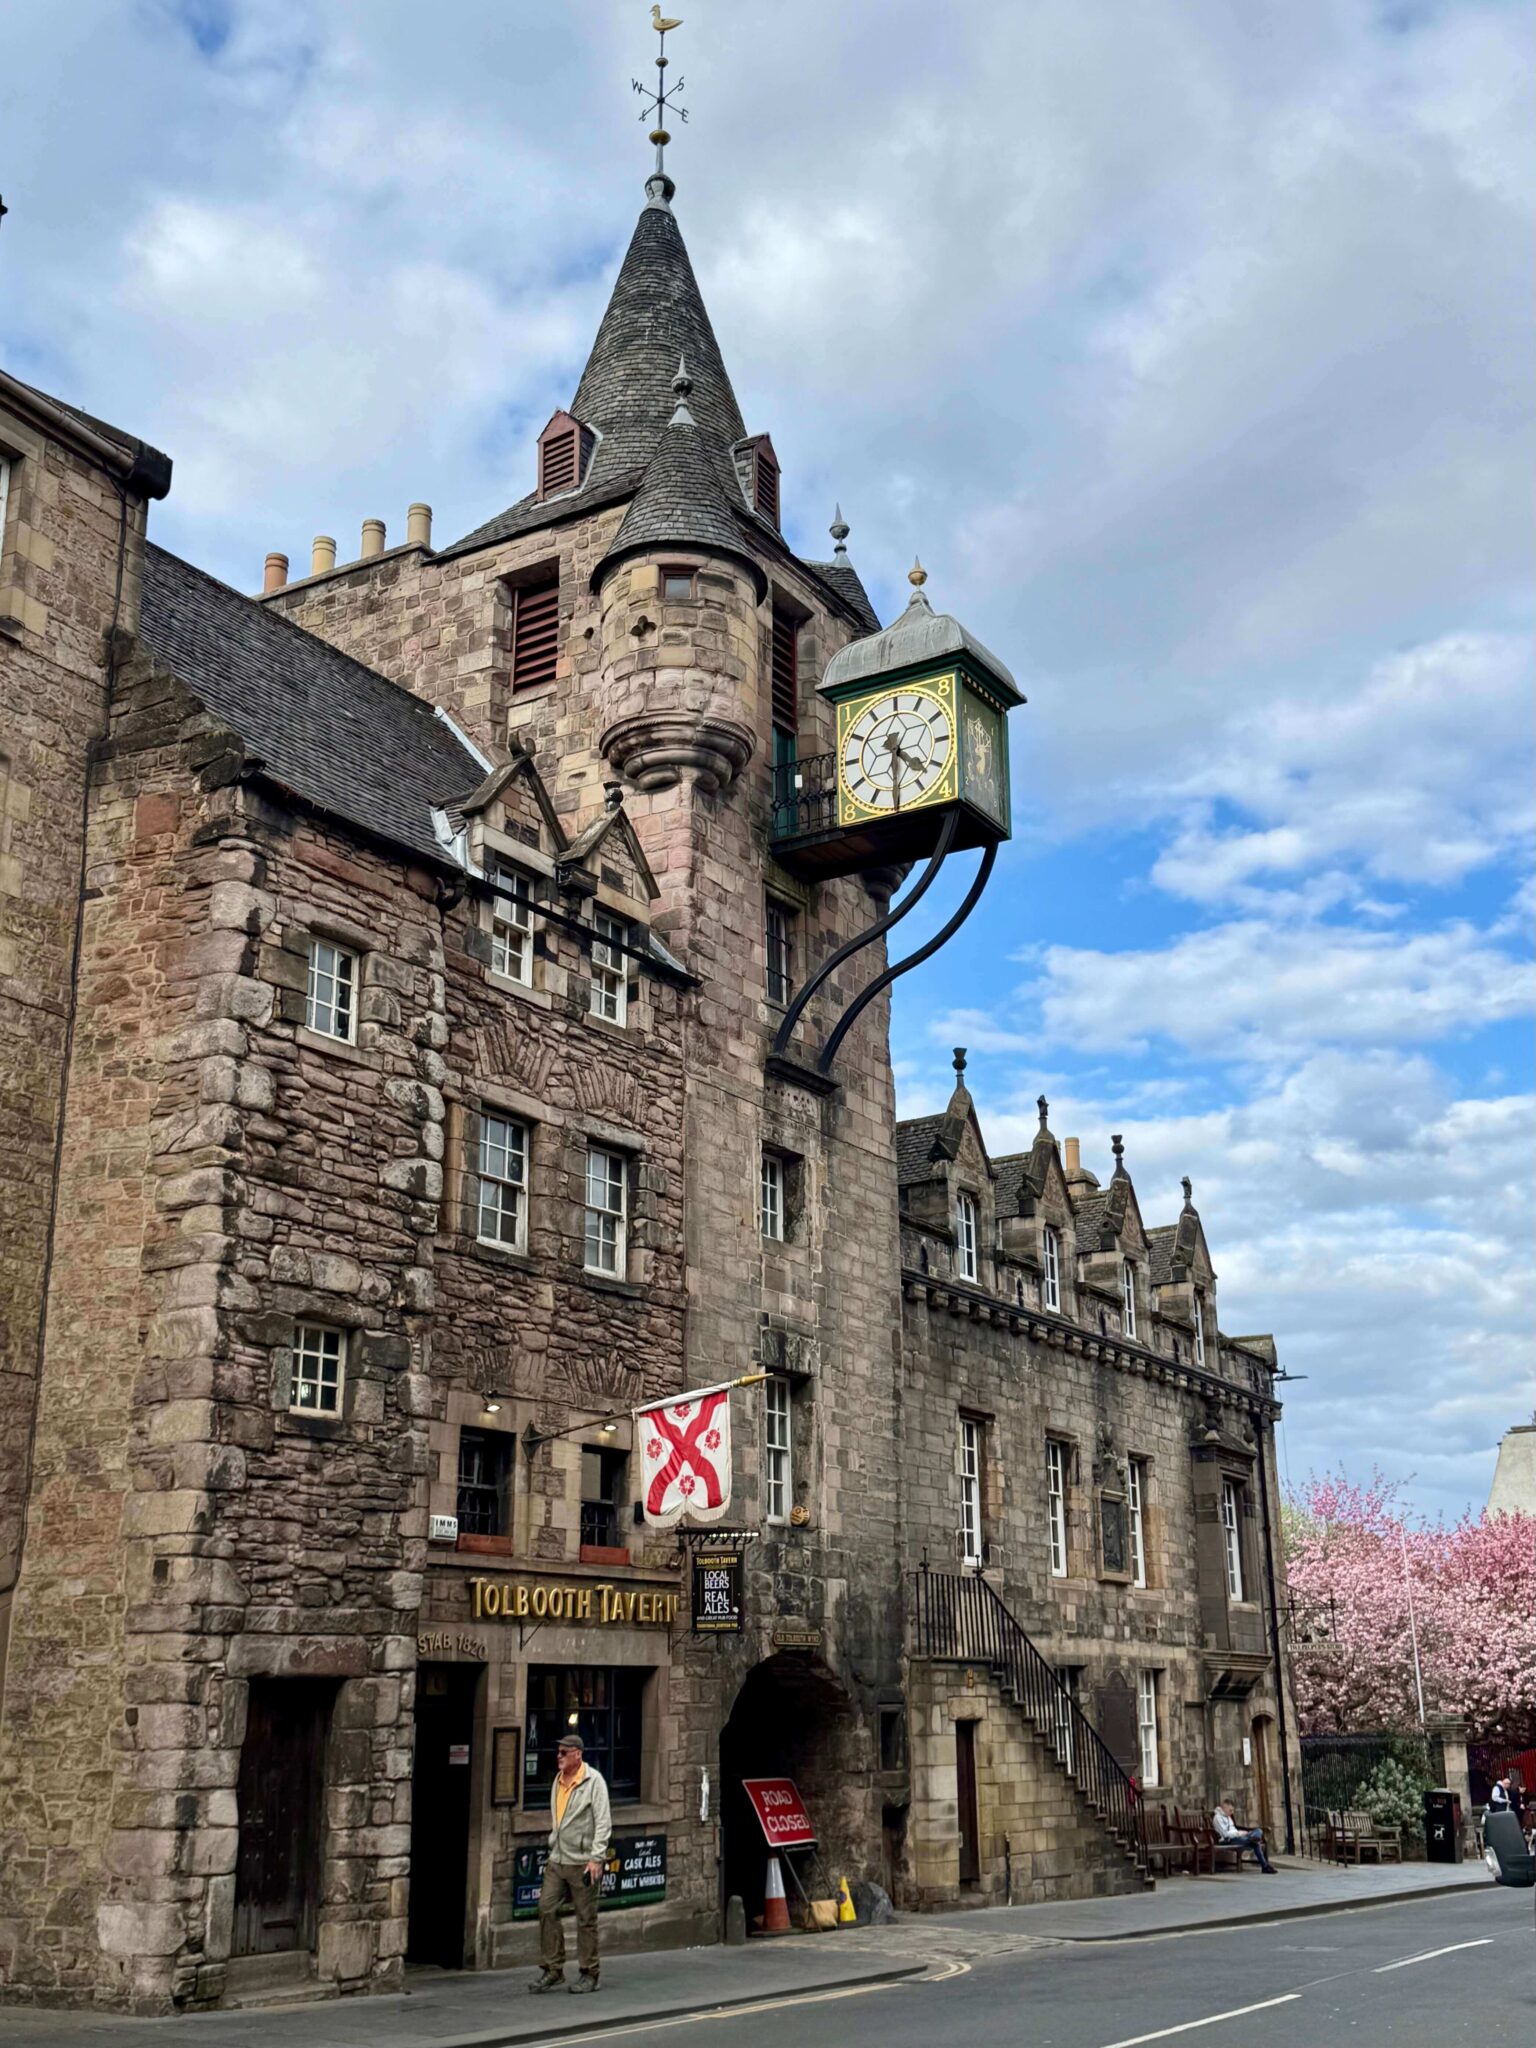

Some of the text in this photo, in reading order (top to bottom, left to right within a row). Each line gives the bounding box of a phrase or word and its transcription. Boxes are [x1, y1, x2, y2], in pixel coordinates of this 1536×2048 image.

[631, 78, 643, 95] W
[677, 76, 685, 92] S
[681, 108, 689, 124] E
[843, 679, 950, 722] 1 8
[844, 780, 952, 821] 8 4
[704, 1570, 729, 1580] LOCAL
[704, 1579, 730, 1589] BEERS
[470, 1576, 680, 1623] TOLBOOTH TAVERN
[704, 1591, 730, 1603] REAL
[704, 1602, 730, 1614] ALES
[457, 1632, 488, 1660] 1820
[761, 1790, 793, 1806] ROAD
[766, 1814, 810, 1833] CLOSED
[624, 1855, 662, 1871] CASK ALES
[621, 1877, 639, 1890] MALT
